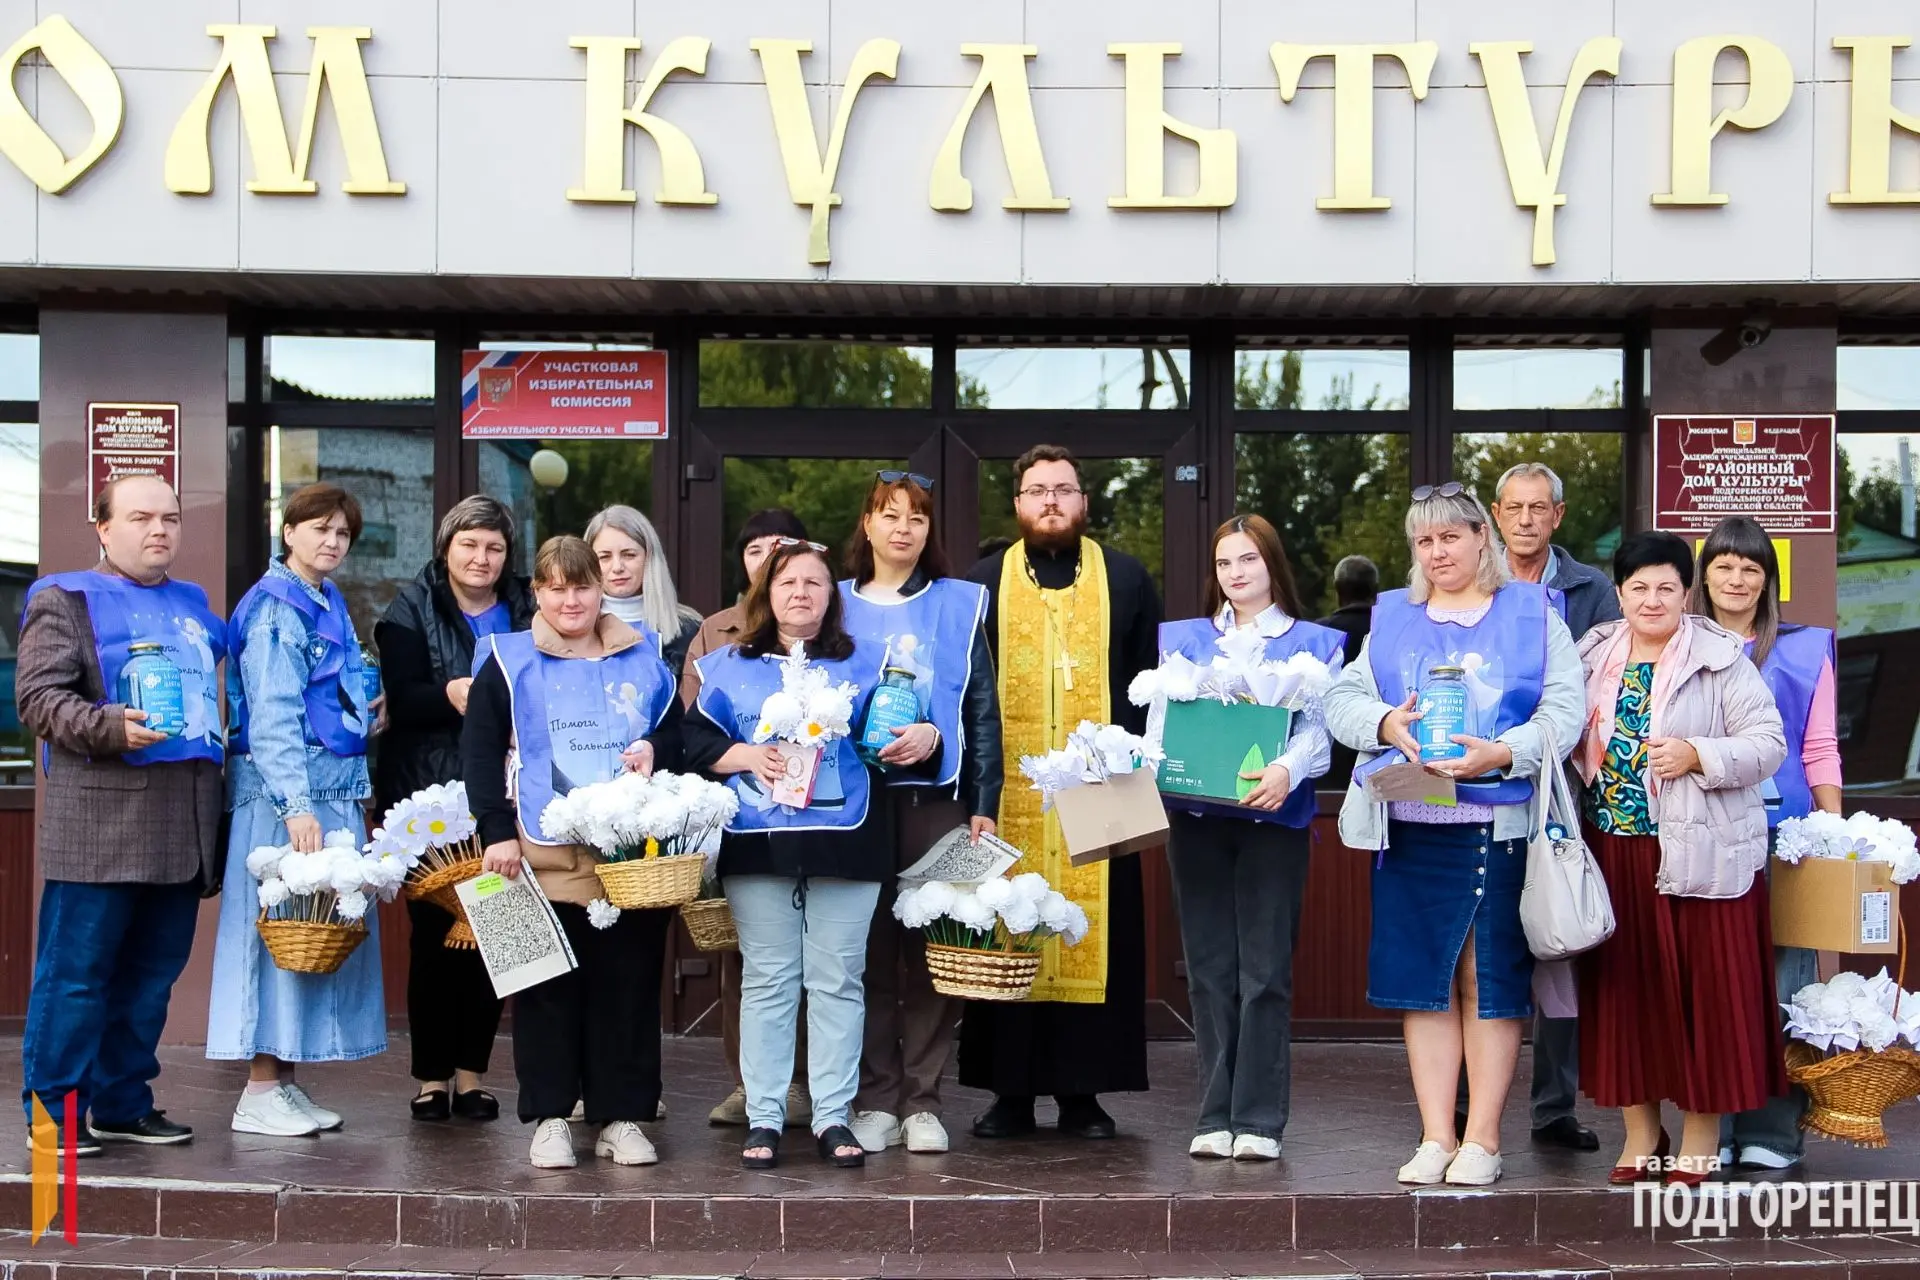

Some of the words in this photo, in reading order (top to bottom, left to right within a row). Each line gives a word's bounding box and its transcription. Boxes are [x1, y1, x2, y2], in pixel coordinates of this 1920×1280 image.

[543, 362, 639, 373] УЧАСТКОВАЯ
[529, 379, 654, 391] ИЗБИРАТЕЛЬНАЯ
[551, 396, 632, 408] КОМИССИЯ
[470, 426, 558, 435] ИЗБИРАТЕЛЬНОГО
[559, 426, 601, 434] УЧАСТКА
[1684, 475, 1716, 488] ДОМ
[1774, 494, 1808, 502] РАЙОНА
[550, 718, 599, 732] Помоги
[736, 713, 761, 725] Пом
[569, 738, 626, 753] больному
